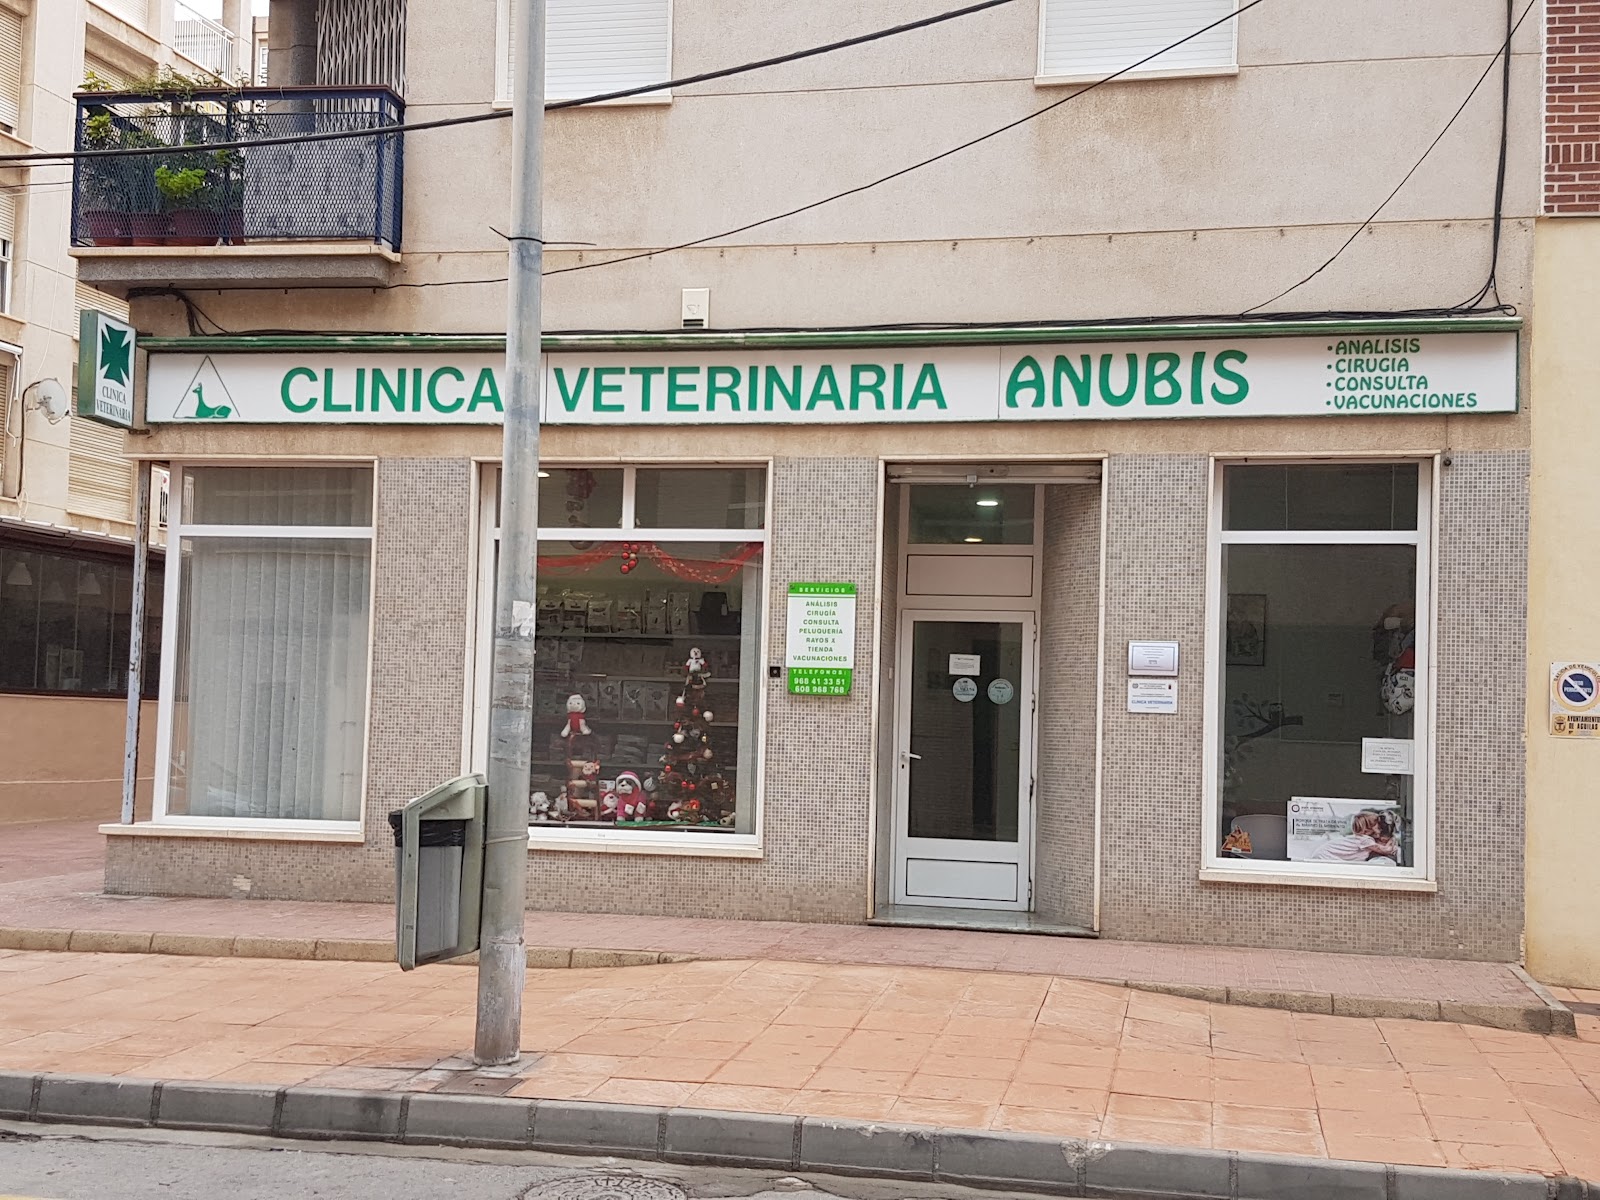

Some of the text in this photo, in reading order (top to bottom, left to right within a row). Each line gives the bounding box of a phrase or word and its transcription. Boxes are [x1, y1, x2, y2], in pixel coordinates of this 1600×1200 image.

[1335, 338, 1420, 355] ANALISIS
[1335, 357, 1409, 373] CIRUGIA
[281, 350, 1249, 413] CLINICA VETERINARIA ANUBIS
[1334, 375, 1428, 391] CONSULTA
[102, 385, 127, 405] CLINICA
[1334, 393, 1477, 409] VACUNACIONES
[96, 399, 131, 422] VETERINARIA
